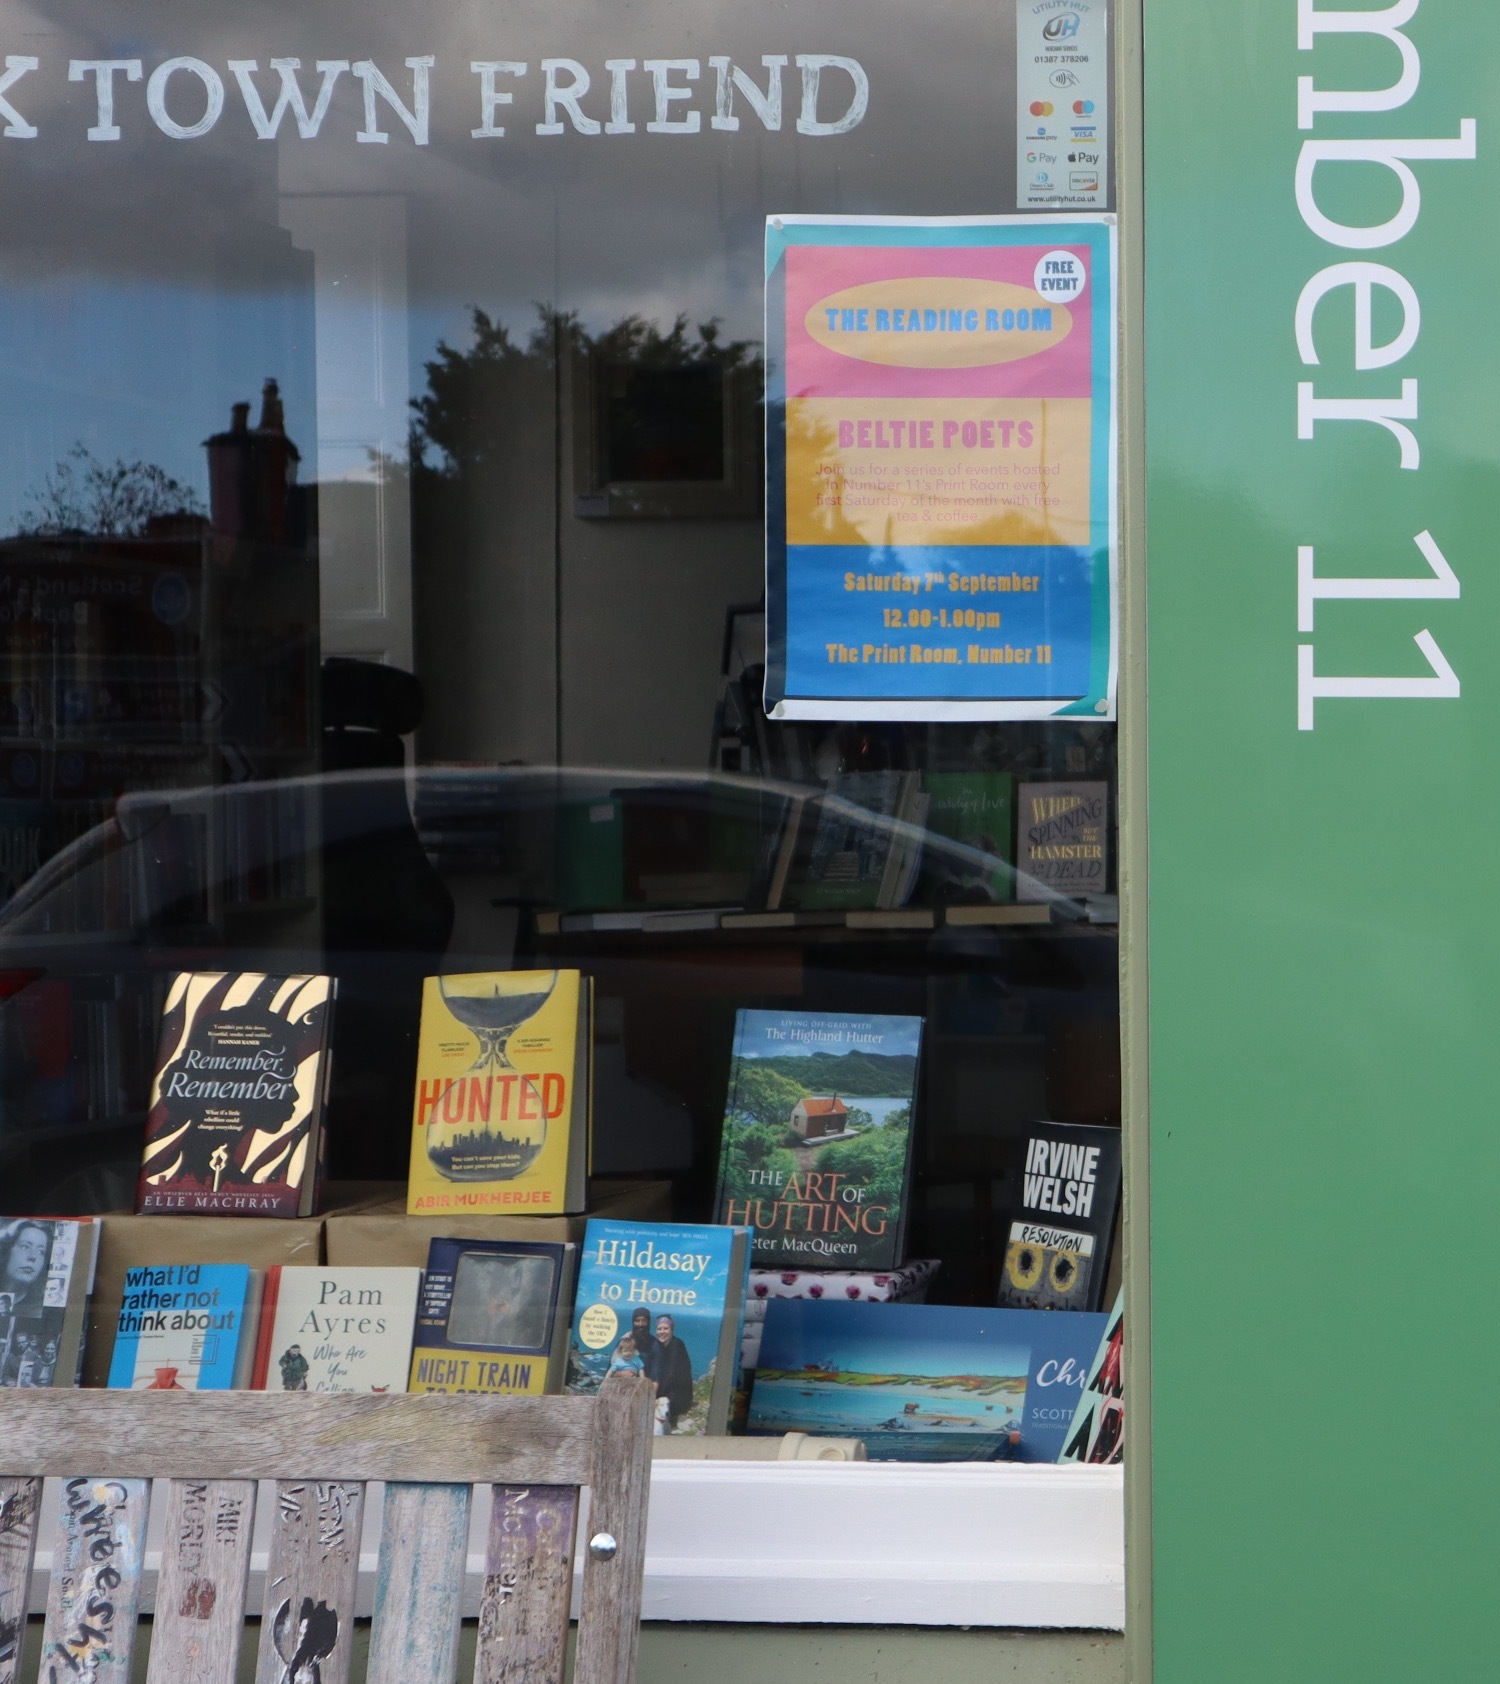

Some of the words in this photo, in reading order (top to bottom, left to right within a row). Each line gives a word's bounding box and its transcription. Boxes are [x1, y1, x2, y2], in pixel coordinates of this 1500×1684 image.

[1035, 55, 1058, 63] 01387
[1060, 55, 1089, 63] 378206
[68, 55, 435, 146] TOWN
[470, 54, 870, 137] FRIEND
[1039, 152, 1057, 165] Pay
[1078, 152, 1099, 165] Pay
[1045, 261, 1074, 275] FREE
[1041, 277, 1079, 291] EVENT
[825, 308, 868, 331] THE
[876, 308, 978, 332] READING
[985, 308, 1052, 331] ROOM
[839, 420, 934, 448] BELTIE
[943, 420, 1034, 448] POETS
[816, 463, 845, 475] Join
[850, 466, 865, 475] us
[869, 463, 888, 475] for
[892, 466, 900, 475] a
[904, 464, 943, 475] series
[947, 463, 962, 475] of
[965, 464, 1009, 475] events
[1013, 463, 1060, 475] hosted
[843, 479, 901, 490] Number
[906, 479, 931, 490] 11's
[936, 479, 965, 490] Print
[970, 479, 1008, 490] Room
[1013, 481, 1050, 493] every
[816, 495, 841, 506] first
[846, 495, 905, 508] Saturday
[910, 495, 924, 506] of
[927, 495, 954, 506] the
[957, 495, 998, 506] month
[1001, 495, 1030, 506] with
[1034, 495, 1060, 506] free
[897, 511, 918, 521] tea
[922, 511, 932, 521] &
[936, 510, 982, 522] coffee.
[844, 572, 921, 596] Saturday
[948, 572, 1039, 596] September
[883, 609, 1000, 631] 12.00-1.00pm
[1297, 529, 1461, 731] 11
[826, 644, 859, 663] The
[862, 644, 905, 664] Print
[967, 645, 1032, 665] Number
[1035, 645, 1051, 664] 11
[1028, 798, 1103, 847] SPINNING
[1031, 845, 1103, 860] HAMSTER
[1046, 860, 1103, 879] DEAD
[765, 1027, 787, 1040] The
[790, 1028, 842, 1044] Highland
[846, 1031, 883, 1044] Hutter
[781, 1019, 808, 1028] LIVING
[811, 1020, 848, 1030] OFF-GRID
[850, 1022, 872, 1030] WITH
[185, 1046, 286, 1071] Remember,
[166, 1066, 297, 1100] Remember
[417, 1072, 565, 1126] HUNTED
[1024, 1138, 1101, 1183] IRVINE
[748, 1169, 783, 1186] THE
[781, 1172, 846, 1201] ART
[842, 1187, 866, 1203] OF
[1022, 1173, 1095, 1218] WELSH
[144, 1195, 186, 1208] ELLE
[194, 1196, 282, 1209] MACHRAY
[415, 1192, 450, 1209] ABIR
[454, 1191, 552, 1206] MUKHERJEE
[726, 1198, 888, 1235] HUTTING
[752, 1237, 777, 1250] eter
[782, 1237, 857, 1255] MacQueen
[1019, 1226, 1083, 1253] RESOLUTION
[596, 1240, 711, 1280] Hildasay
[126, 1266, 173, 1287] what
[177, 1265, 201, 1286] I'd
[121, 1288, 180, 1310] rather
[184, 1287, 220, 1308] not
[317, 1280, 383, 1306] Pam
[600, 1281, 622, 1300] to
[627, 1279, 696, 1305] Home
[118, 1310, 167, 1332] think
[170, 1309, 236, 1331] about
[298, 1309, 386, 1341] Ayres
[313, 1344, 342, 1360] Who
[345, 1346, 367, 1362] Are
[327, 1362, 348, 1382] You
[417, 1358, 470, 1385] NIGHT
[478, 1361, 531, 1389] TRAIN
